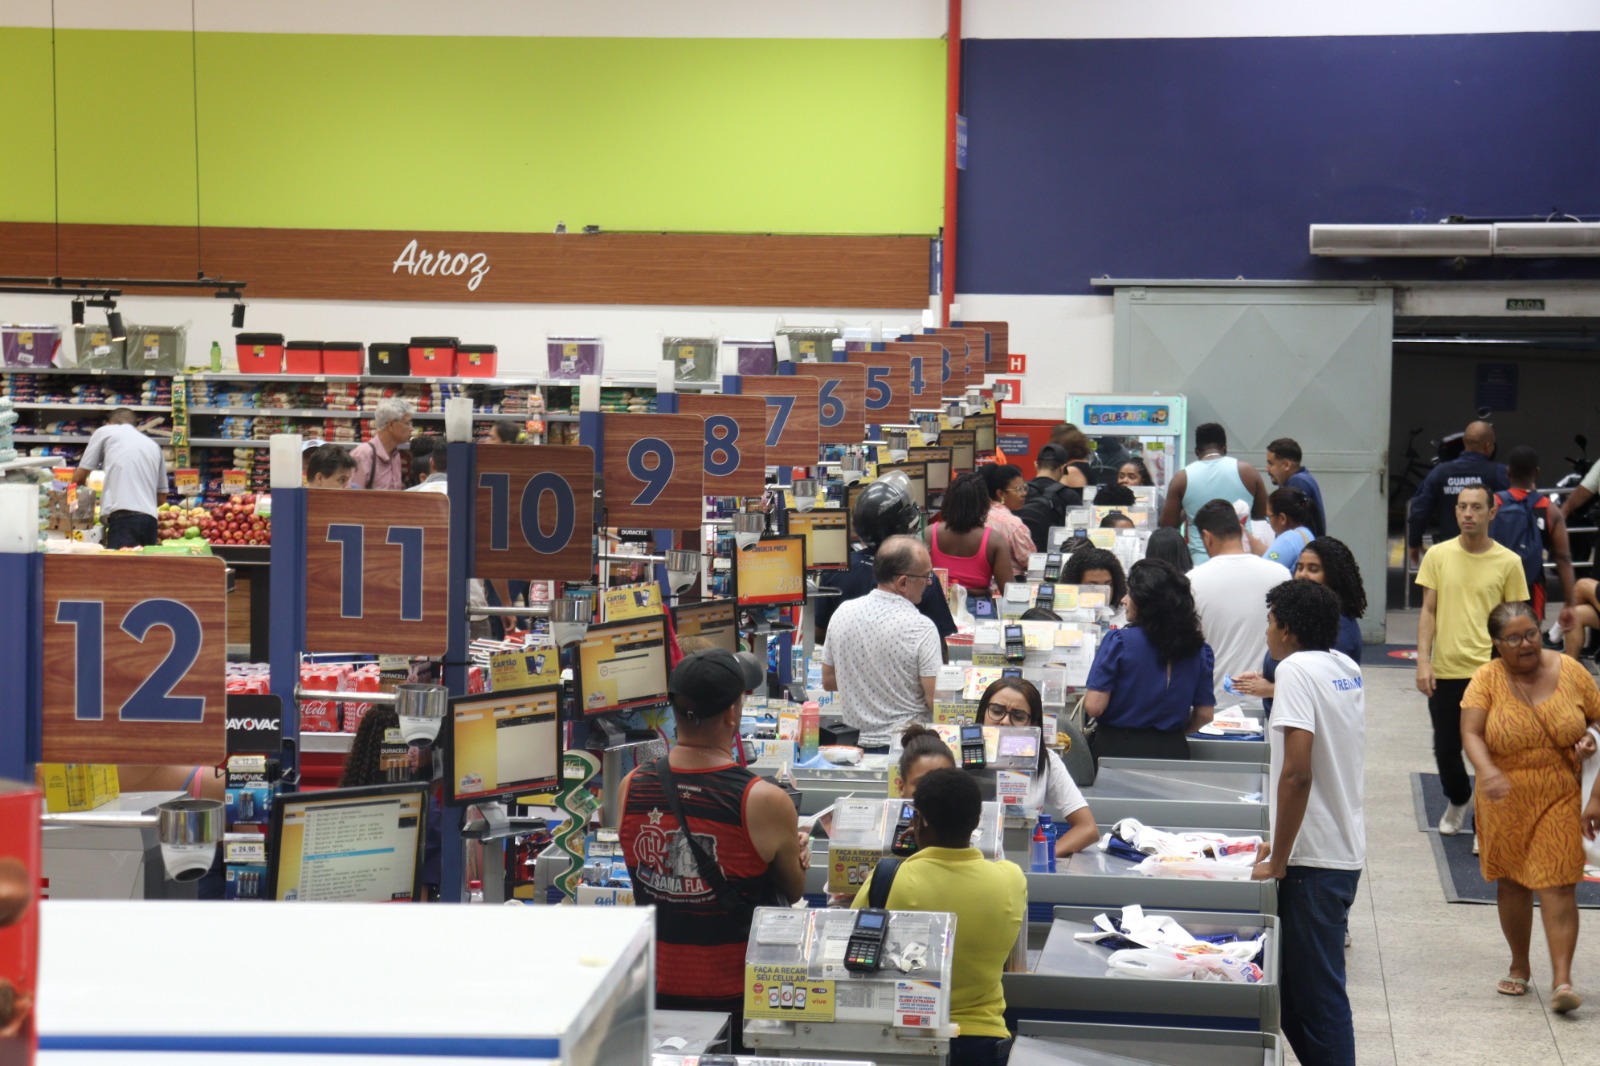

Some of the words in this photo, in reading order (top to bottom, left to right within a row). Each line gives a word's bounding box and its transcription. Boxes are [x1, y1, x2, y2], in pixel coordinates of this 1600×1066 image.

[393, 239, 490, 291] Arroz
[1509, 301, 1544, 310] SAÍDA
[865, 366, 892, 410] 5
[1010, 358, 1021, 370] H
[765, 396, 797, 447] 7
[819, 379, 845, 427] 6
[704, 415, 740, 476] 8
[627, 437, 675, 506] 9
[1448, 477, 1481, 486] GUARDA
[479, 472, 576, 555] 10
[325, 523, 425, 621] 11
[55, 598, 207, 723] 12
[493, 658, 517, 668] CARTÃO
[685, 879, 704, 892] FLA
[754, 966, 773, 975] FAÇA
